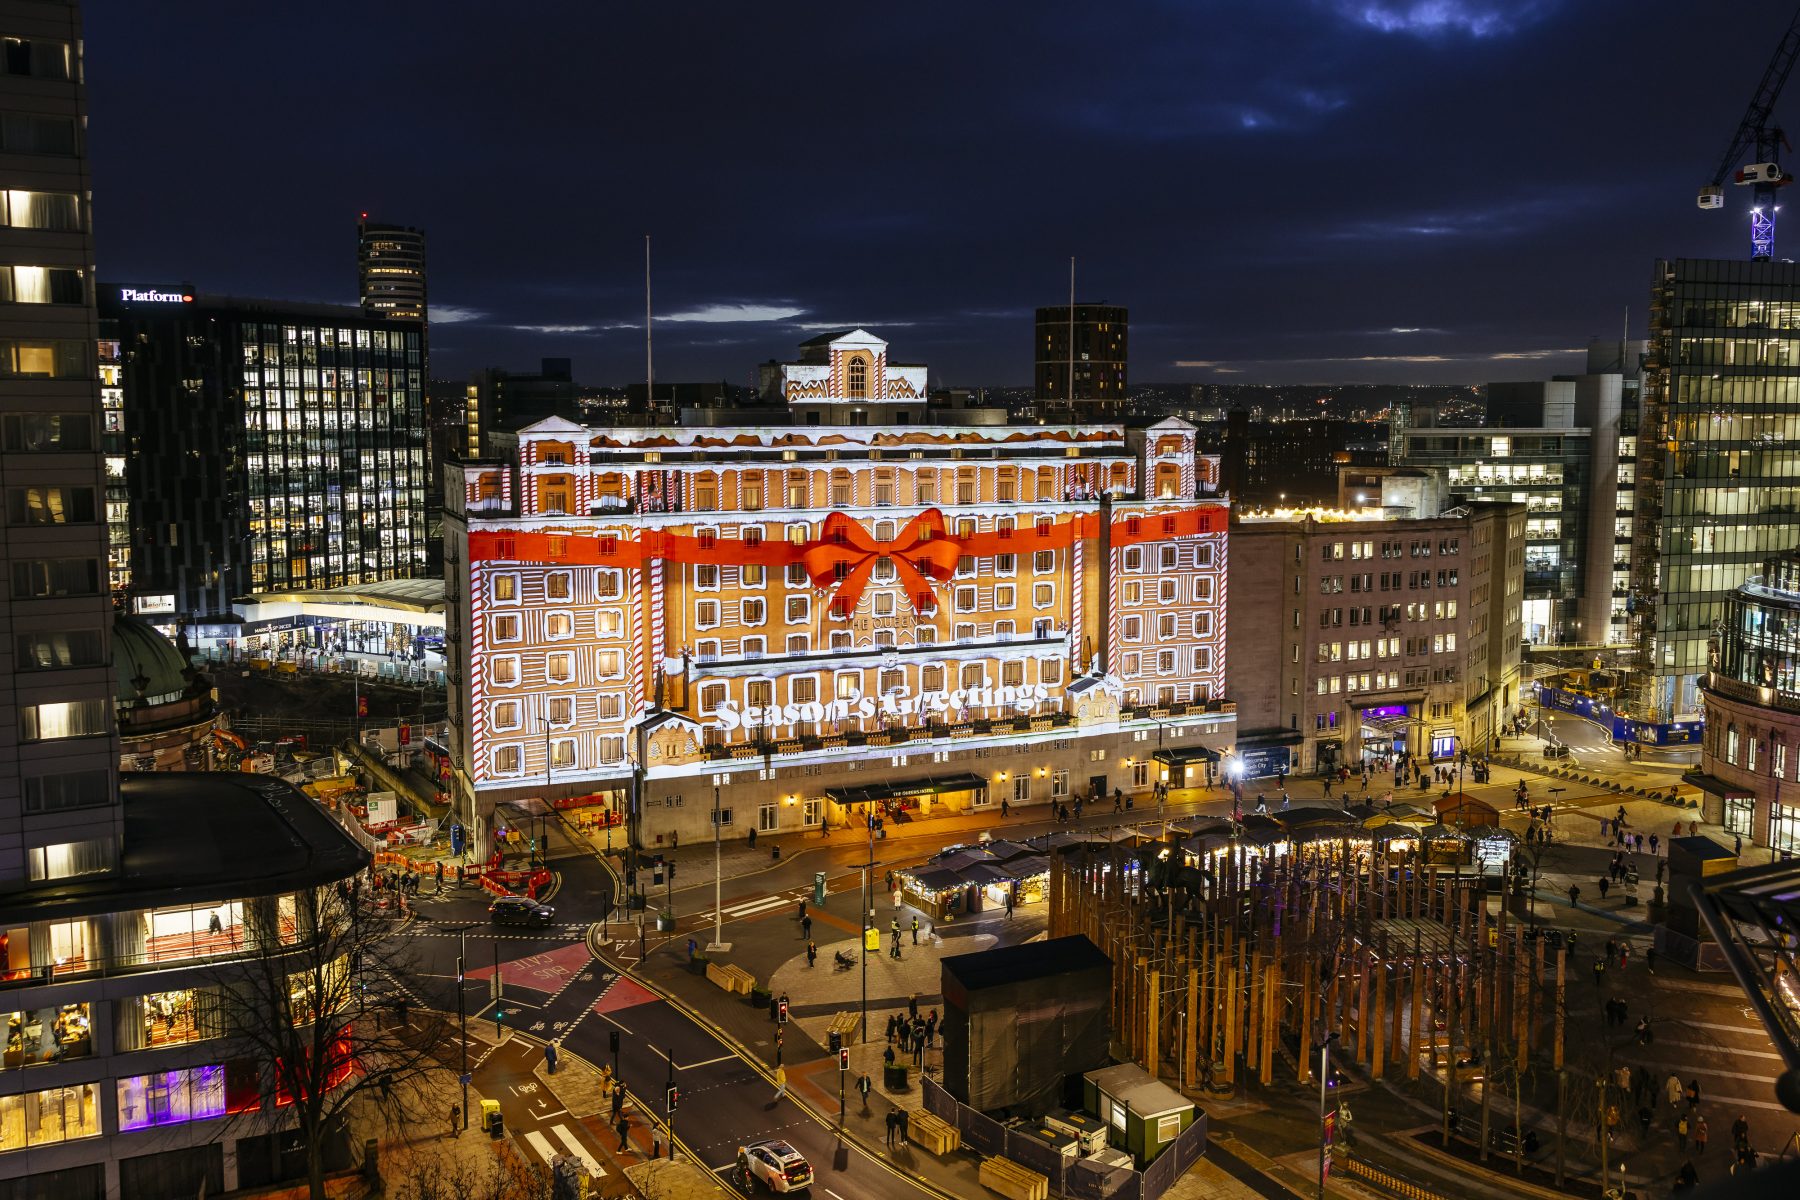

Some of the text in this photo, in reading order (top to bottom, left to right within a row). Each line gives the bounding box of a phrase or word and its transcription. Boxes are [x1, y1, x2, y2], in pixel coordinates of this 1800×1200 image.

[121, 289, 183, 302] Platform
[873, 615, 925, 629] QUEENS
[716, 676, 1048, 731] Season's Greetings
[511, 954, 553, 971] GATE
[532, 965, 570, 980] BUS
